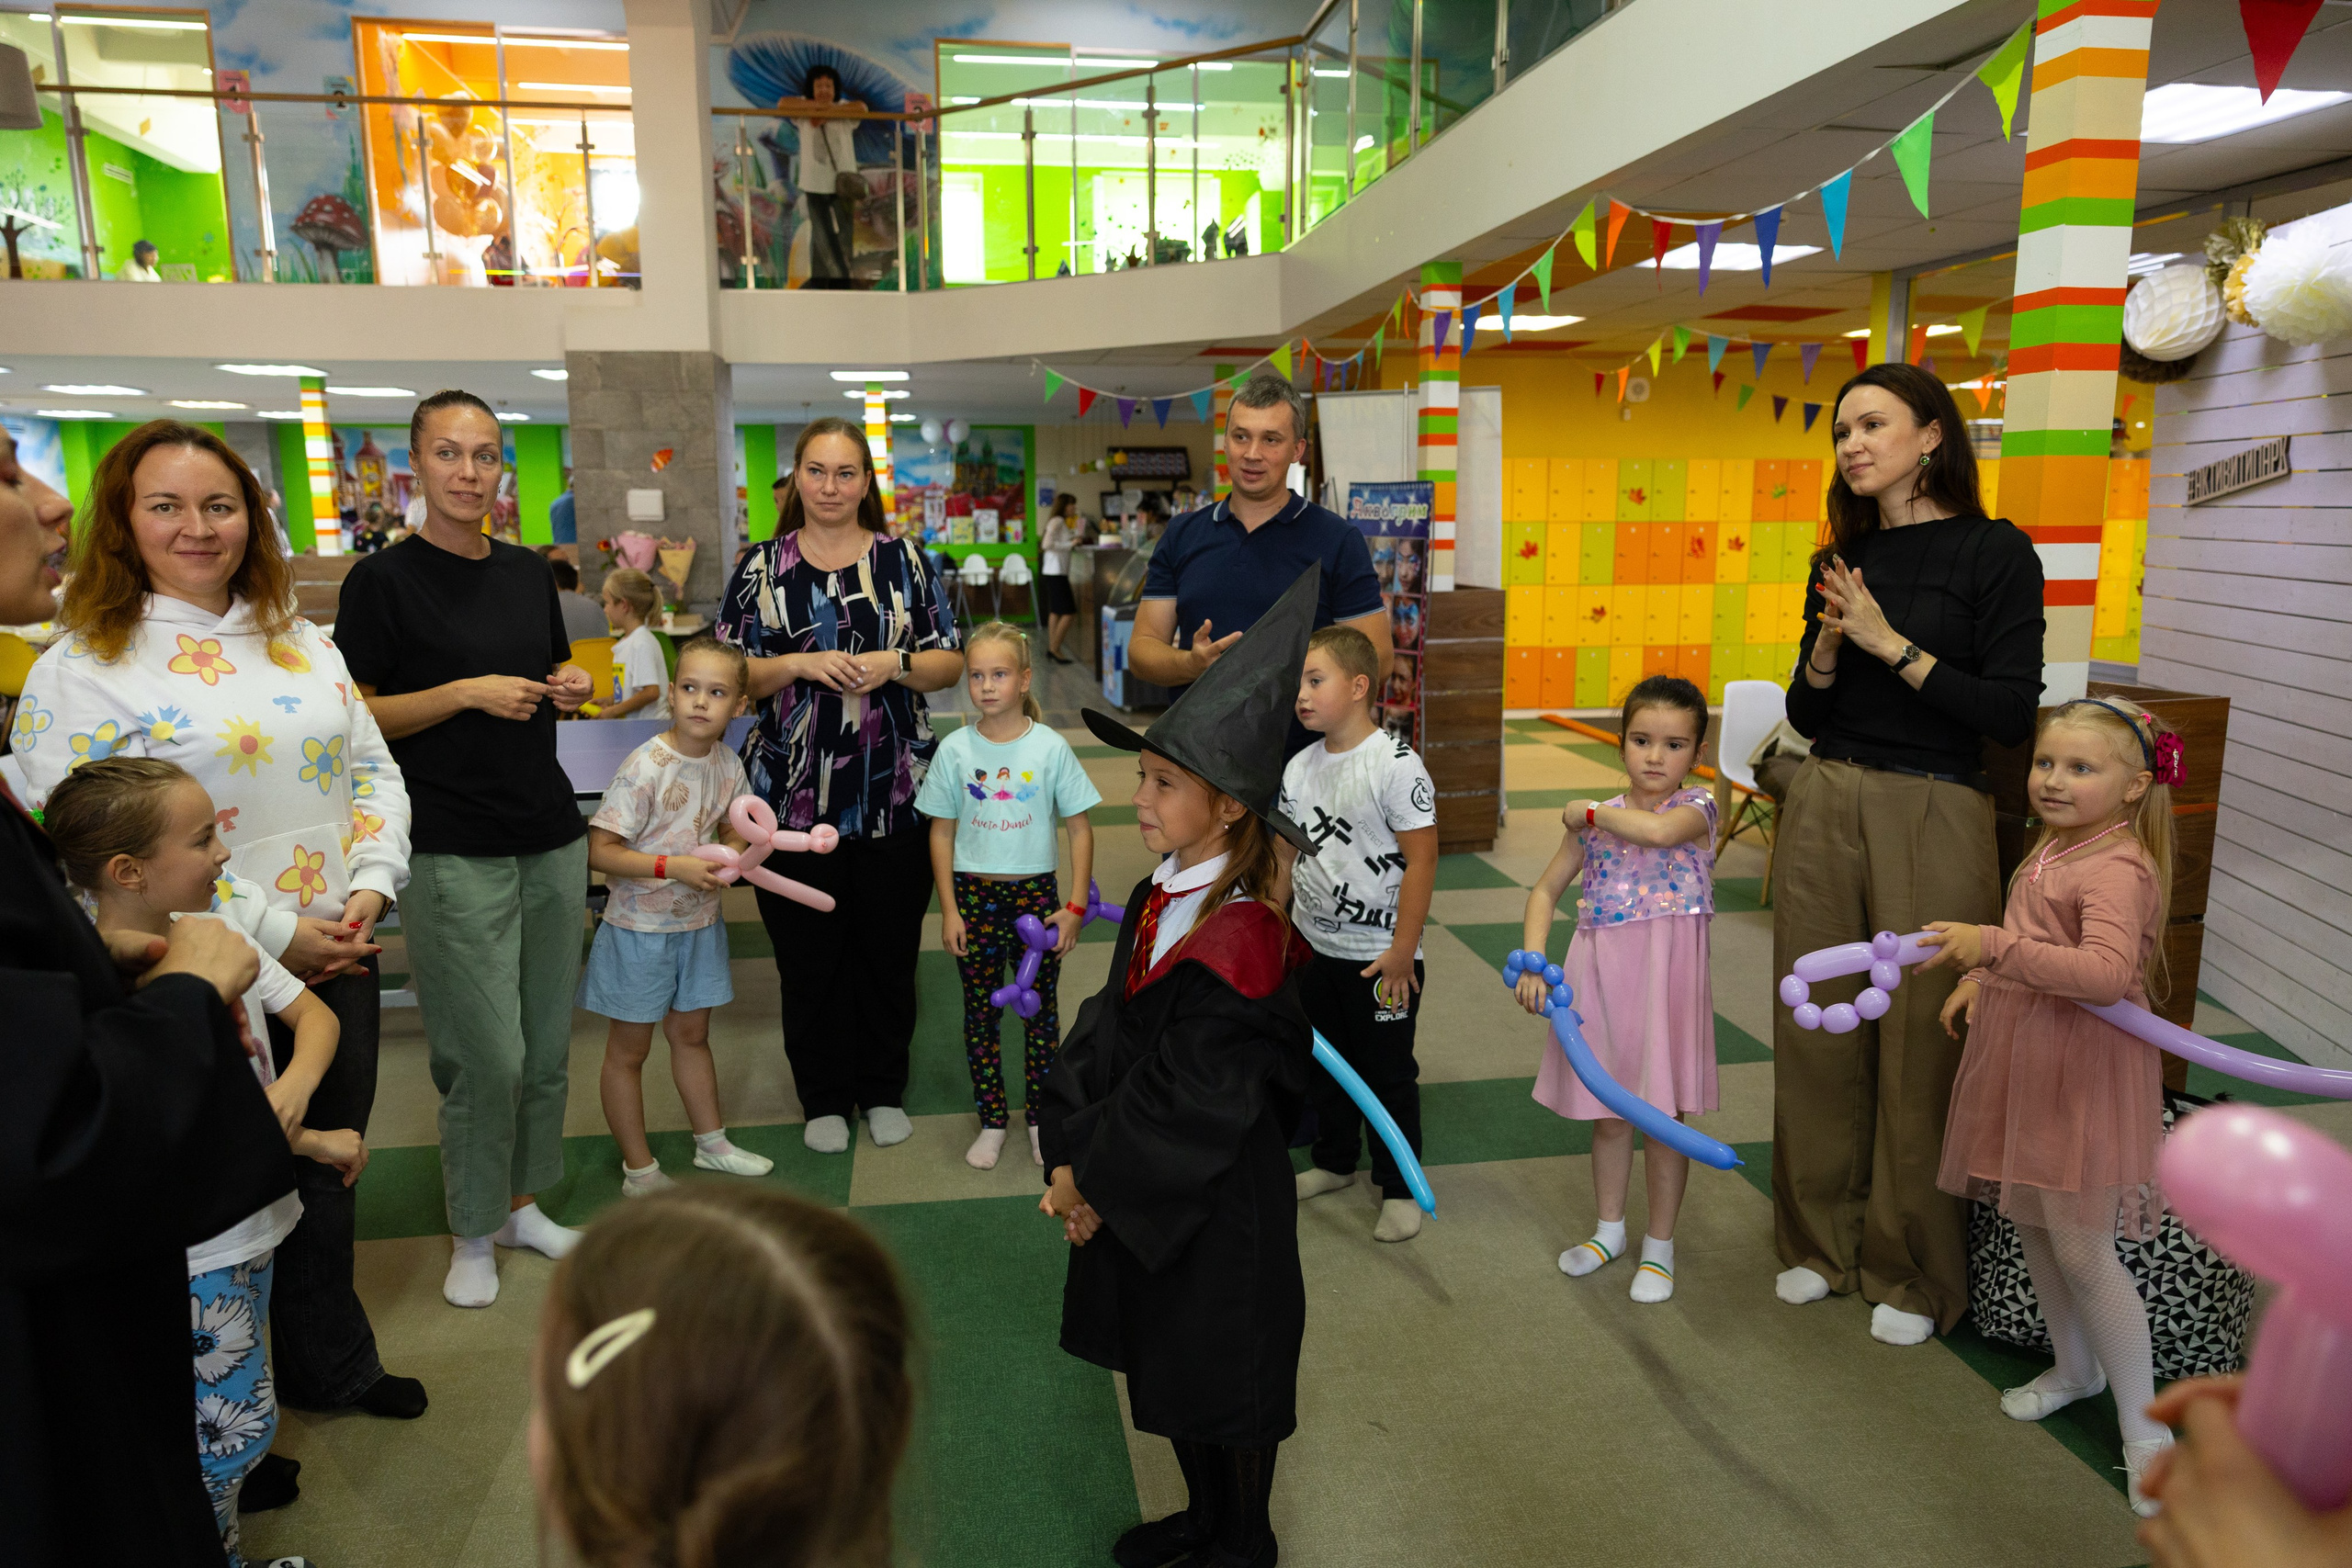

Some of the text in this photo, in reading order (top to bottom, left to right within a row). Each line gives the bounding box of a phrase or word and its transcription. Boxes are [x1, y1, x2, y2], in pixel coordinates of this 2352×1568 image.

[2188, 435, 2289, 502] #АКТИВИТИПАРК
[1358, 818, 1385, 848] PERFECT
[1374, 1010, 1408, 1021] EXPLORE
